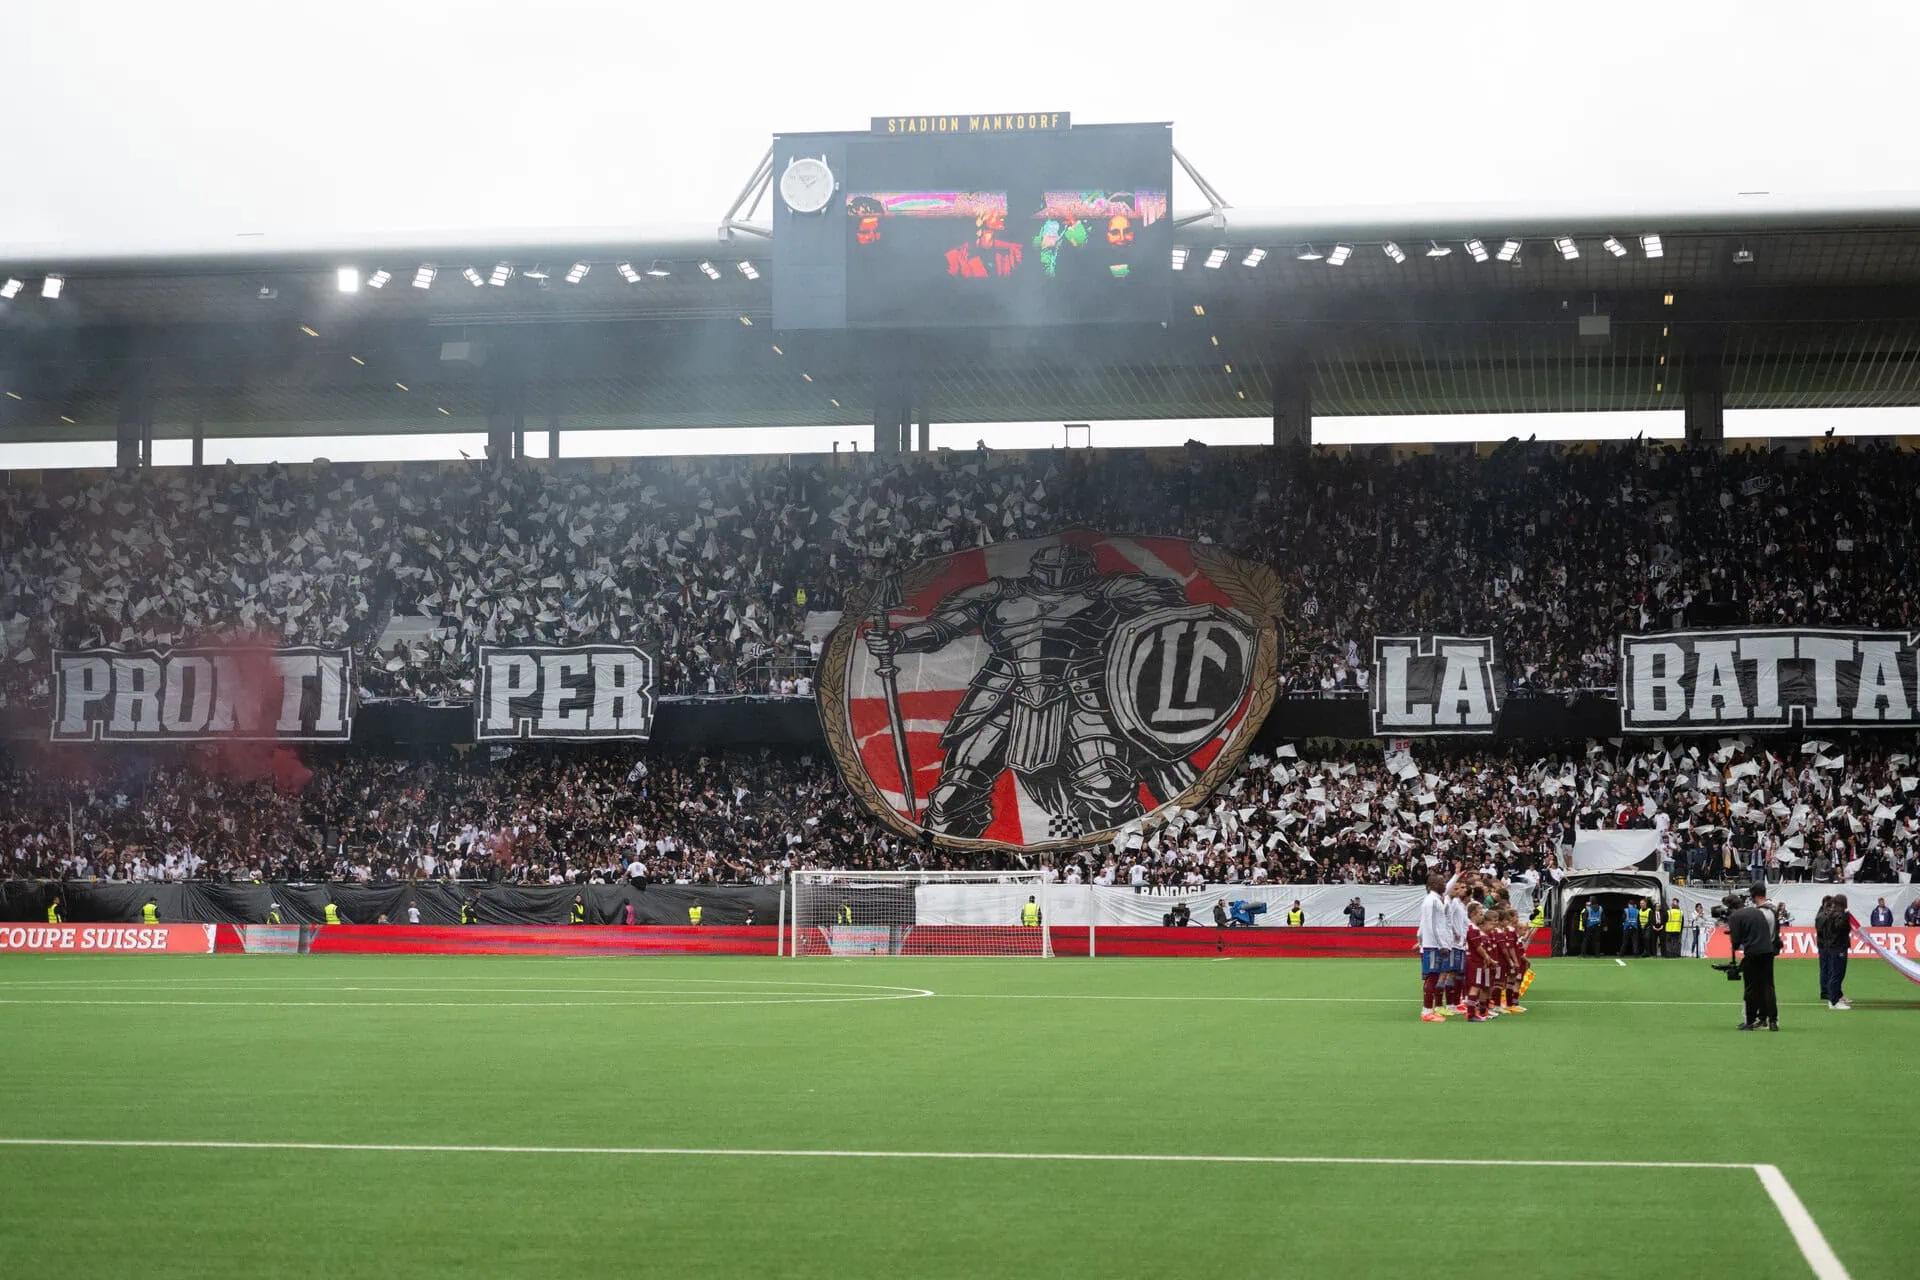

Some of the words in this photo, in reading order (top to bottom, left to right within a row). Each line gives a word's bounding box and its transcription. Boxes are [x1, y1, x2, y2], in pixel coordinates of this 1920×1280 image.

[888, 117, 959, 133] STADION
[969, 113, 1059, 131] WANKDORF
[60, 656, 343, 732] PRONTI
[487, 653, 645, 730] PER
[1383, 646, 1492, 725] LA
[1630, 637, 1920, 721] BATTA
[0, 927, 76, 948] COUPE
[81, 928, 168, 949] SUISSE
